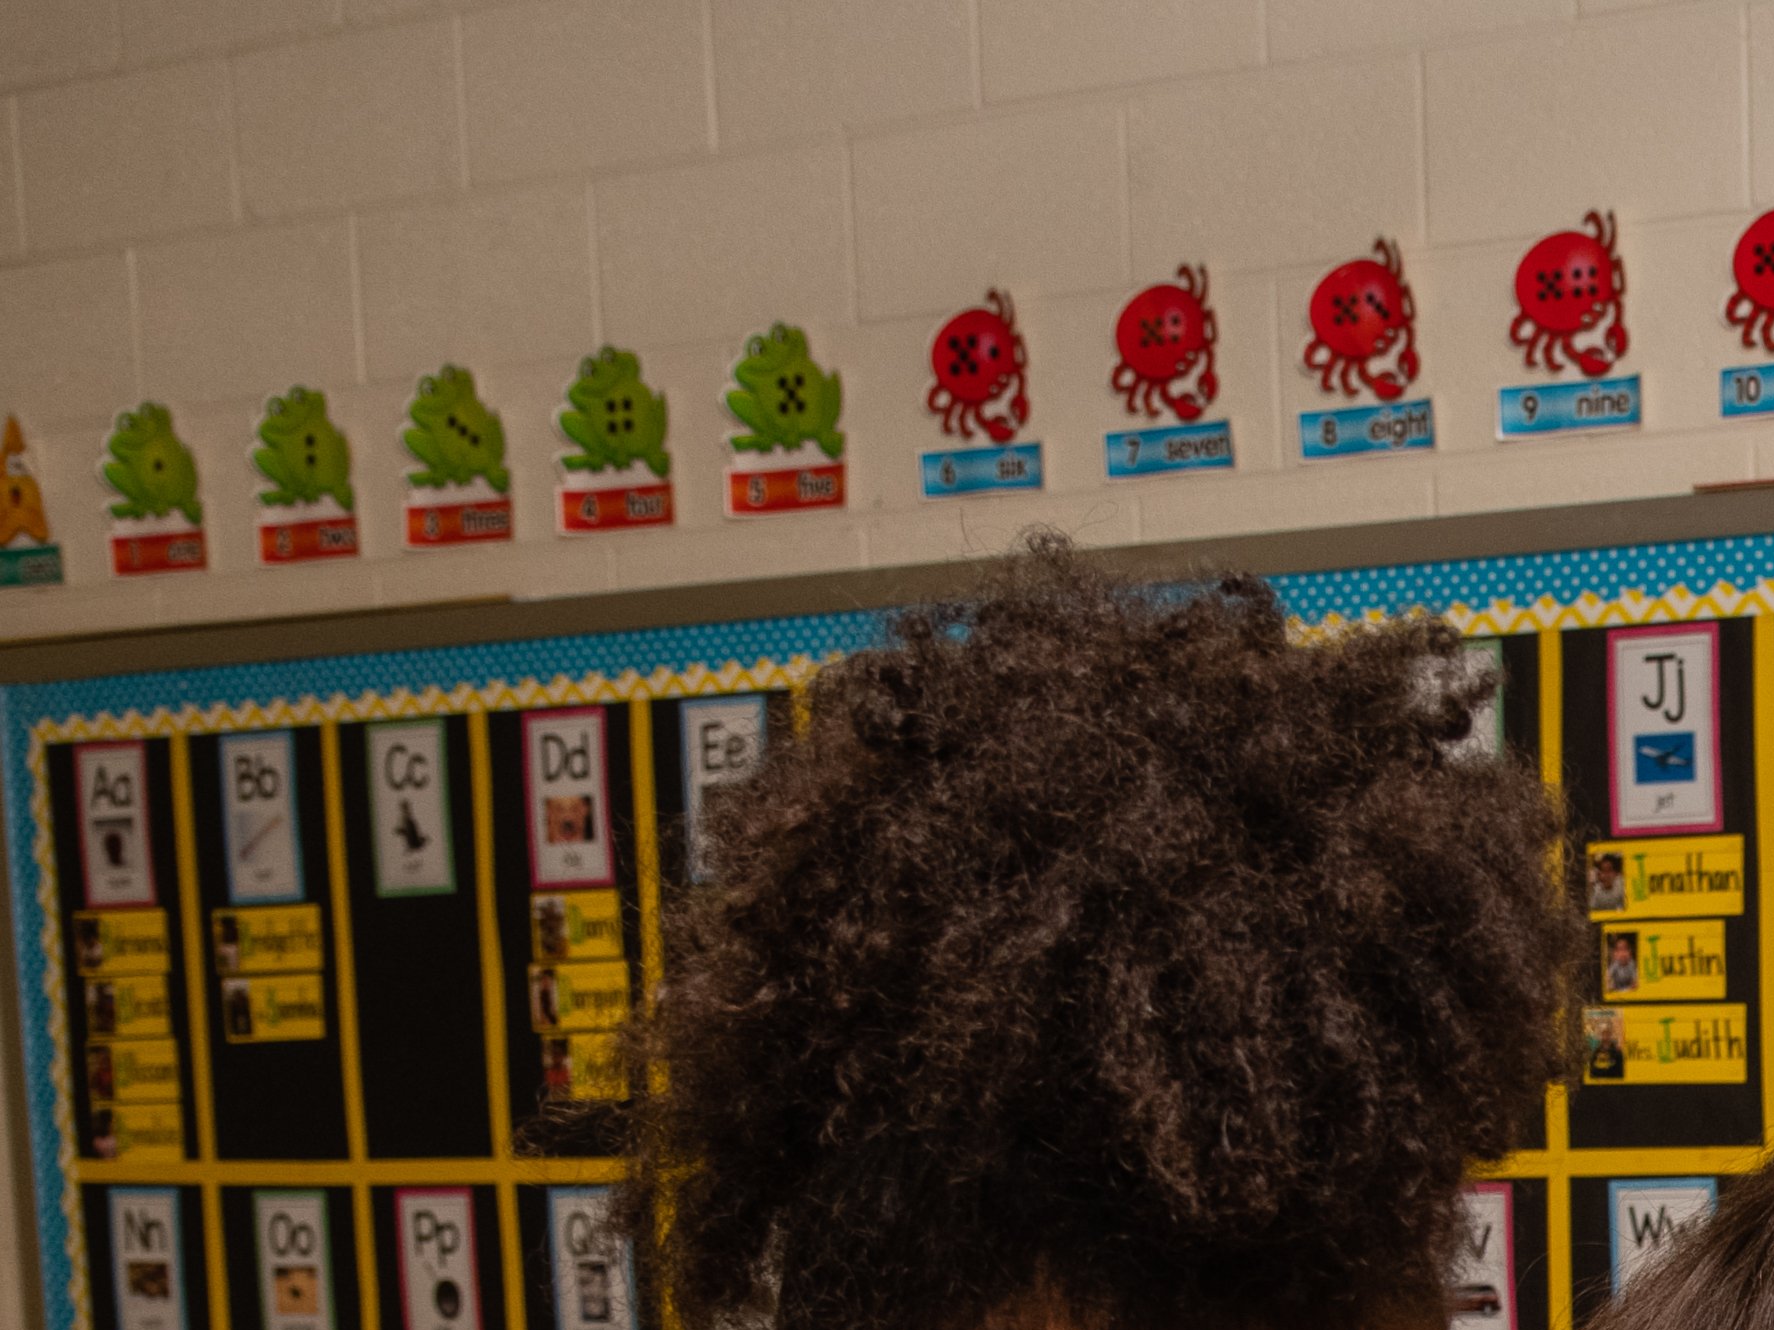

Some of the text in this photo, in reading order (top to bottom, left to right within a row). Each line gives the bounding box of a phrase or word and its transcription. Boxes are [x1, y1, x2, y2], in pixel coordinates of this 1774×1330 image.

[1522, 384, 1631, 420] 9 nine
[1734, 374, 1760, 403] 10
[1125, 432, 1229, 465] 7 seven
[1321, 409, 1433, 447] 8 eight
[941, 456, 1029, 486] 6 six
[1641, 652, 1686, 724] Jj
[385, 743, 431, 792] Cc
[541, 730, 591, 783] Dd
[702, 720, 748, 771] Ee
[92, 764, 133, 808] Aa
[234, 754, 282, 803] Bb
[1631, 852, 1743, 902] Jonathan
[1644, 934, 1727, 983] Justin
[1656, 1017, 1746, 1064] Judith
[124, 1207, 167, 1253] Nn
[268, 1212, 317, 1258] Oo
[412, 1208, 461, 1267] Pp
